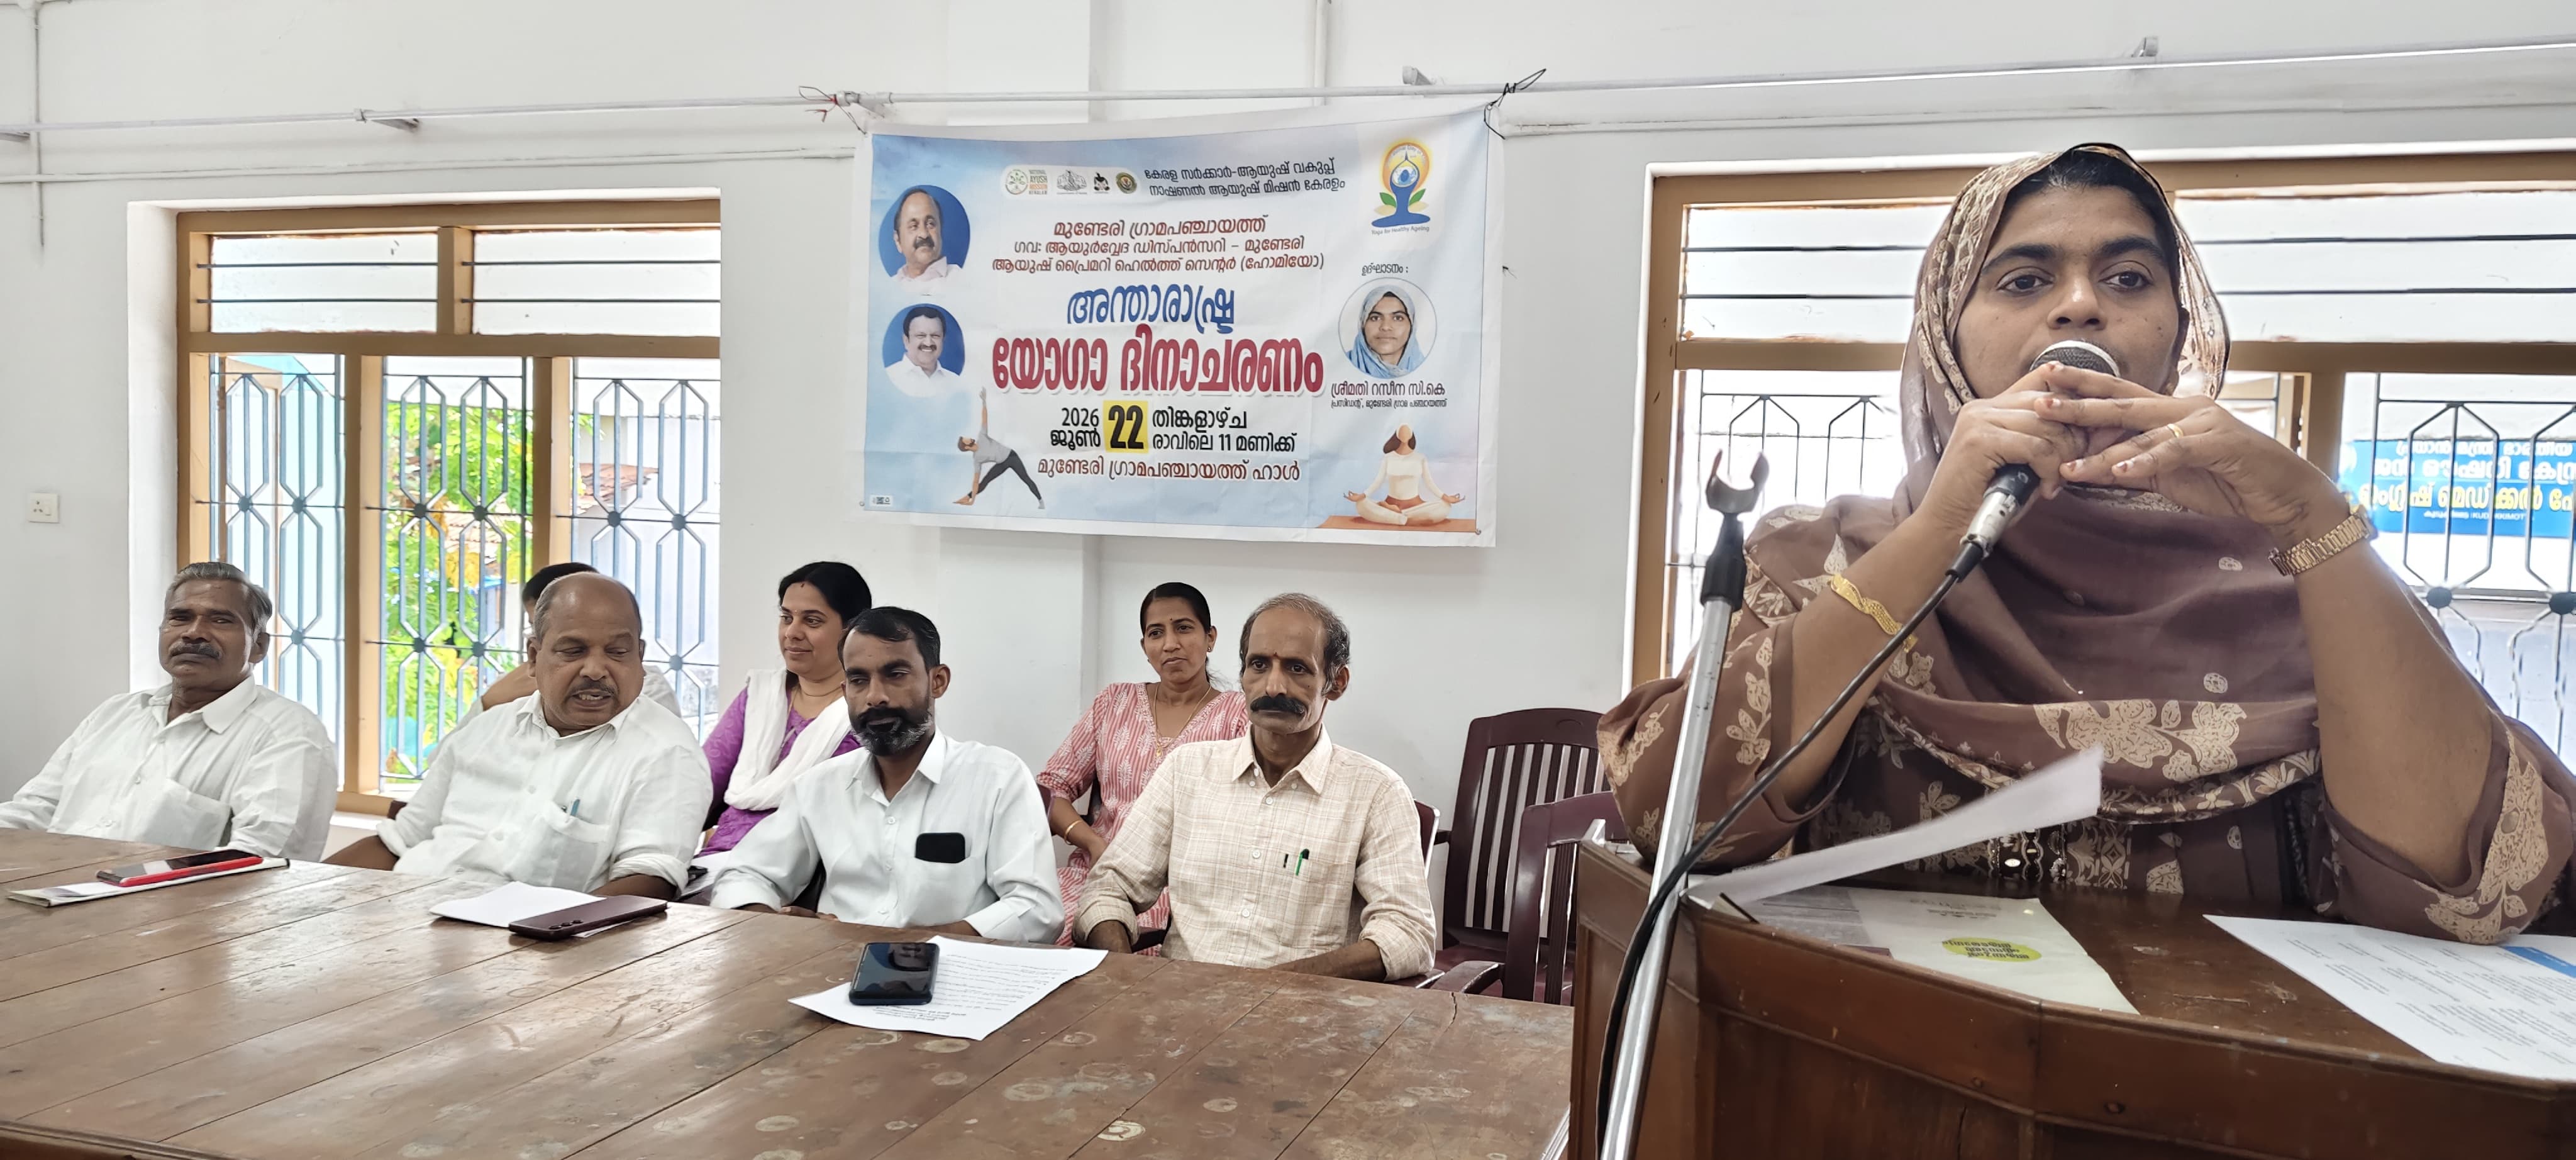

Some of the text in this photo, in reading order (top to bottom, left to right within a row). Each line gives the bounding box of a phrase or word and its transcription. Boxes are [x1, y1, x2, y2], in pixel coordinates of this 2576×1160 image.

[1144, 157, 1335, 182] കേരള സർക്കാർ-ആയുഷ് വകുപ്പ്
[1150, 177, 1346, 197] നാഷണൽ ആയുഷ് മിഷൻ കേരളം
[1053, 214, 1269, 240] മുണ്ടേരി ഗ്രാമപഞ്ചായത്ത്
[1045, 241, 1130, 257] ആയുർവ്വേദ
[1133, 237, 1226, 254] ഡിസ്പൻസറി
[1245, 235, 1305, 254] മുണ്ടേരി
[992, 257, 1053, 274] ആയുഷ്
[1055, 257, 1111, 274] പ്രൈമറി
[1114, 257, 1183, 272] ഹെൽത്ത്
[1240, 252, 1324, 272] (ഹോമിയോ)
[1067, 284, 1235, 334] അന്താരാഷ്ട്ര
[992, 323, 1324, 393] യോഗാ ദിനാചരണം
[1331, 380, 1445, 398] ശ്രീമതി റസീന സി.കെ
[1061, 407, 1099, 427] 2026
[1108, 404, 1145, 449] 22
[1152, 405, 1248, 433] തിങ്കളാഴ്ച
[1050, 427, 1101, 451] ജൂൺ
[1152, 430, 1297, 452] രാവിലെ 11 മണിക്ക്
[1038, 455, 1300, 481] മുണ്ടേരി ഗ്രാമപഞ്ചായത്ത് ഹാൾ
